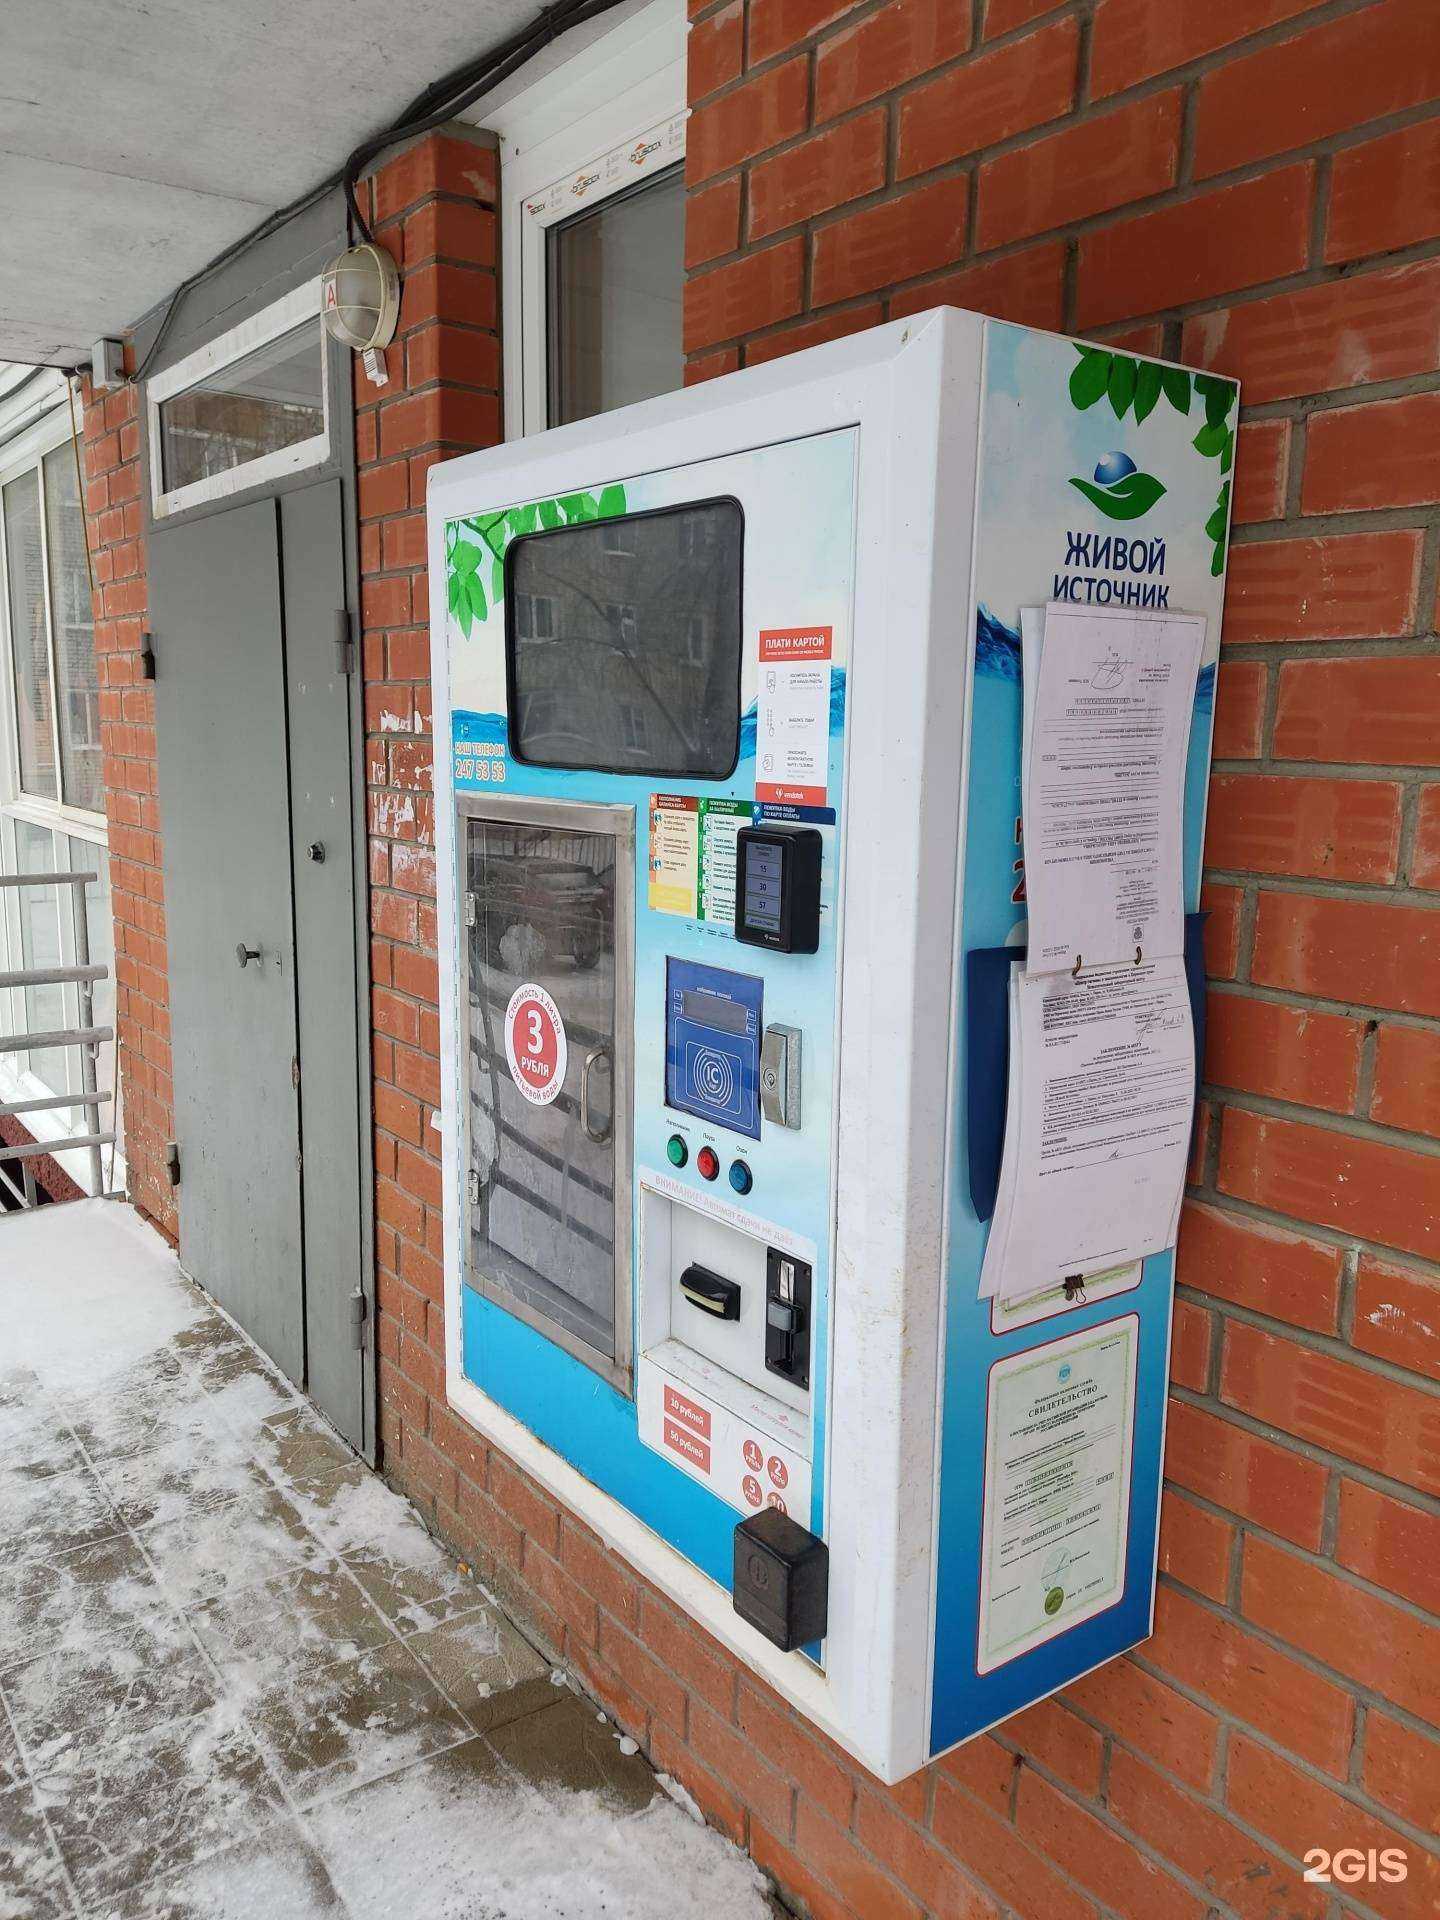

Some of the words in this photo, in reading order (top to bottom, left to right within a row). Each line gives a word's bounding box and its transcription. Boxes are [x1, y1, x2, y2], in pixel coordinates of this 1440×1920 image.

[1064, 530, 1167, 576] ЖИВОЙ
[1052, 573, 1170, 608] ИСТОЧНИК
[765, 638, 792, 649] ПЛАТИ
[793, 633, 825, 648] КАРТОЙ
[527, 1009, 544, 1055] 3
[521, 1056, 549, 1078] РУБЛЯ
[671, 1398, 679, 1410] 10
[679, 1404, 704, 1427] рублей
[1028, 1384, 1098, 1418] СВИДЕТЕЛЬСТВО
[670, 1430, 678, 1442] 50
[679, 1437, 704, 1460] рублей
[750, 1443, 756, 1460] 1
[774, 1460, 782, 1477] 2
[749, 1479, 756, 1494] 5
